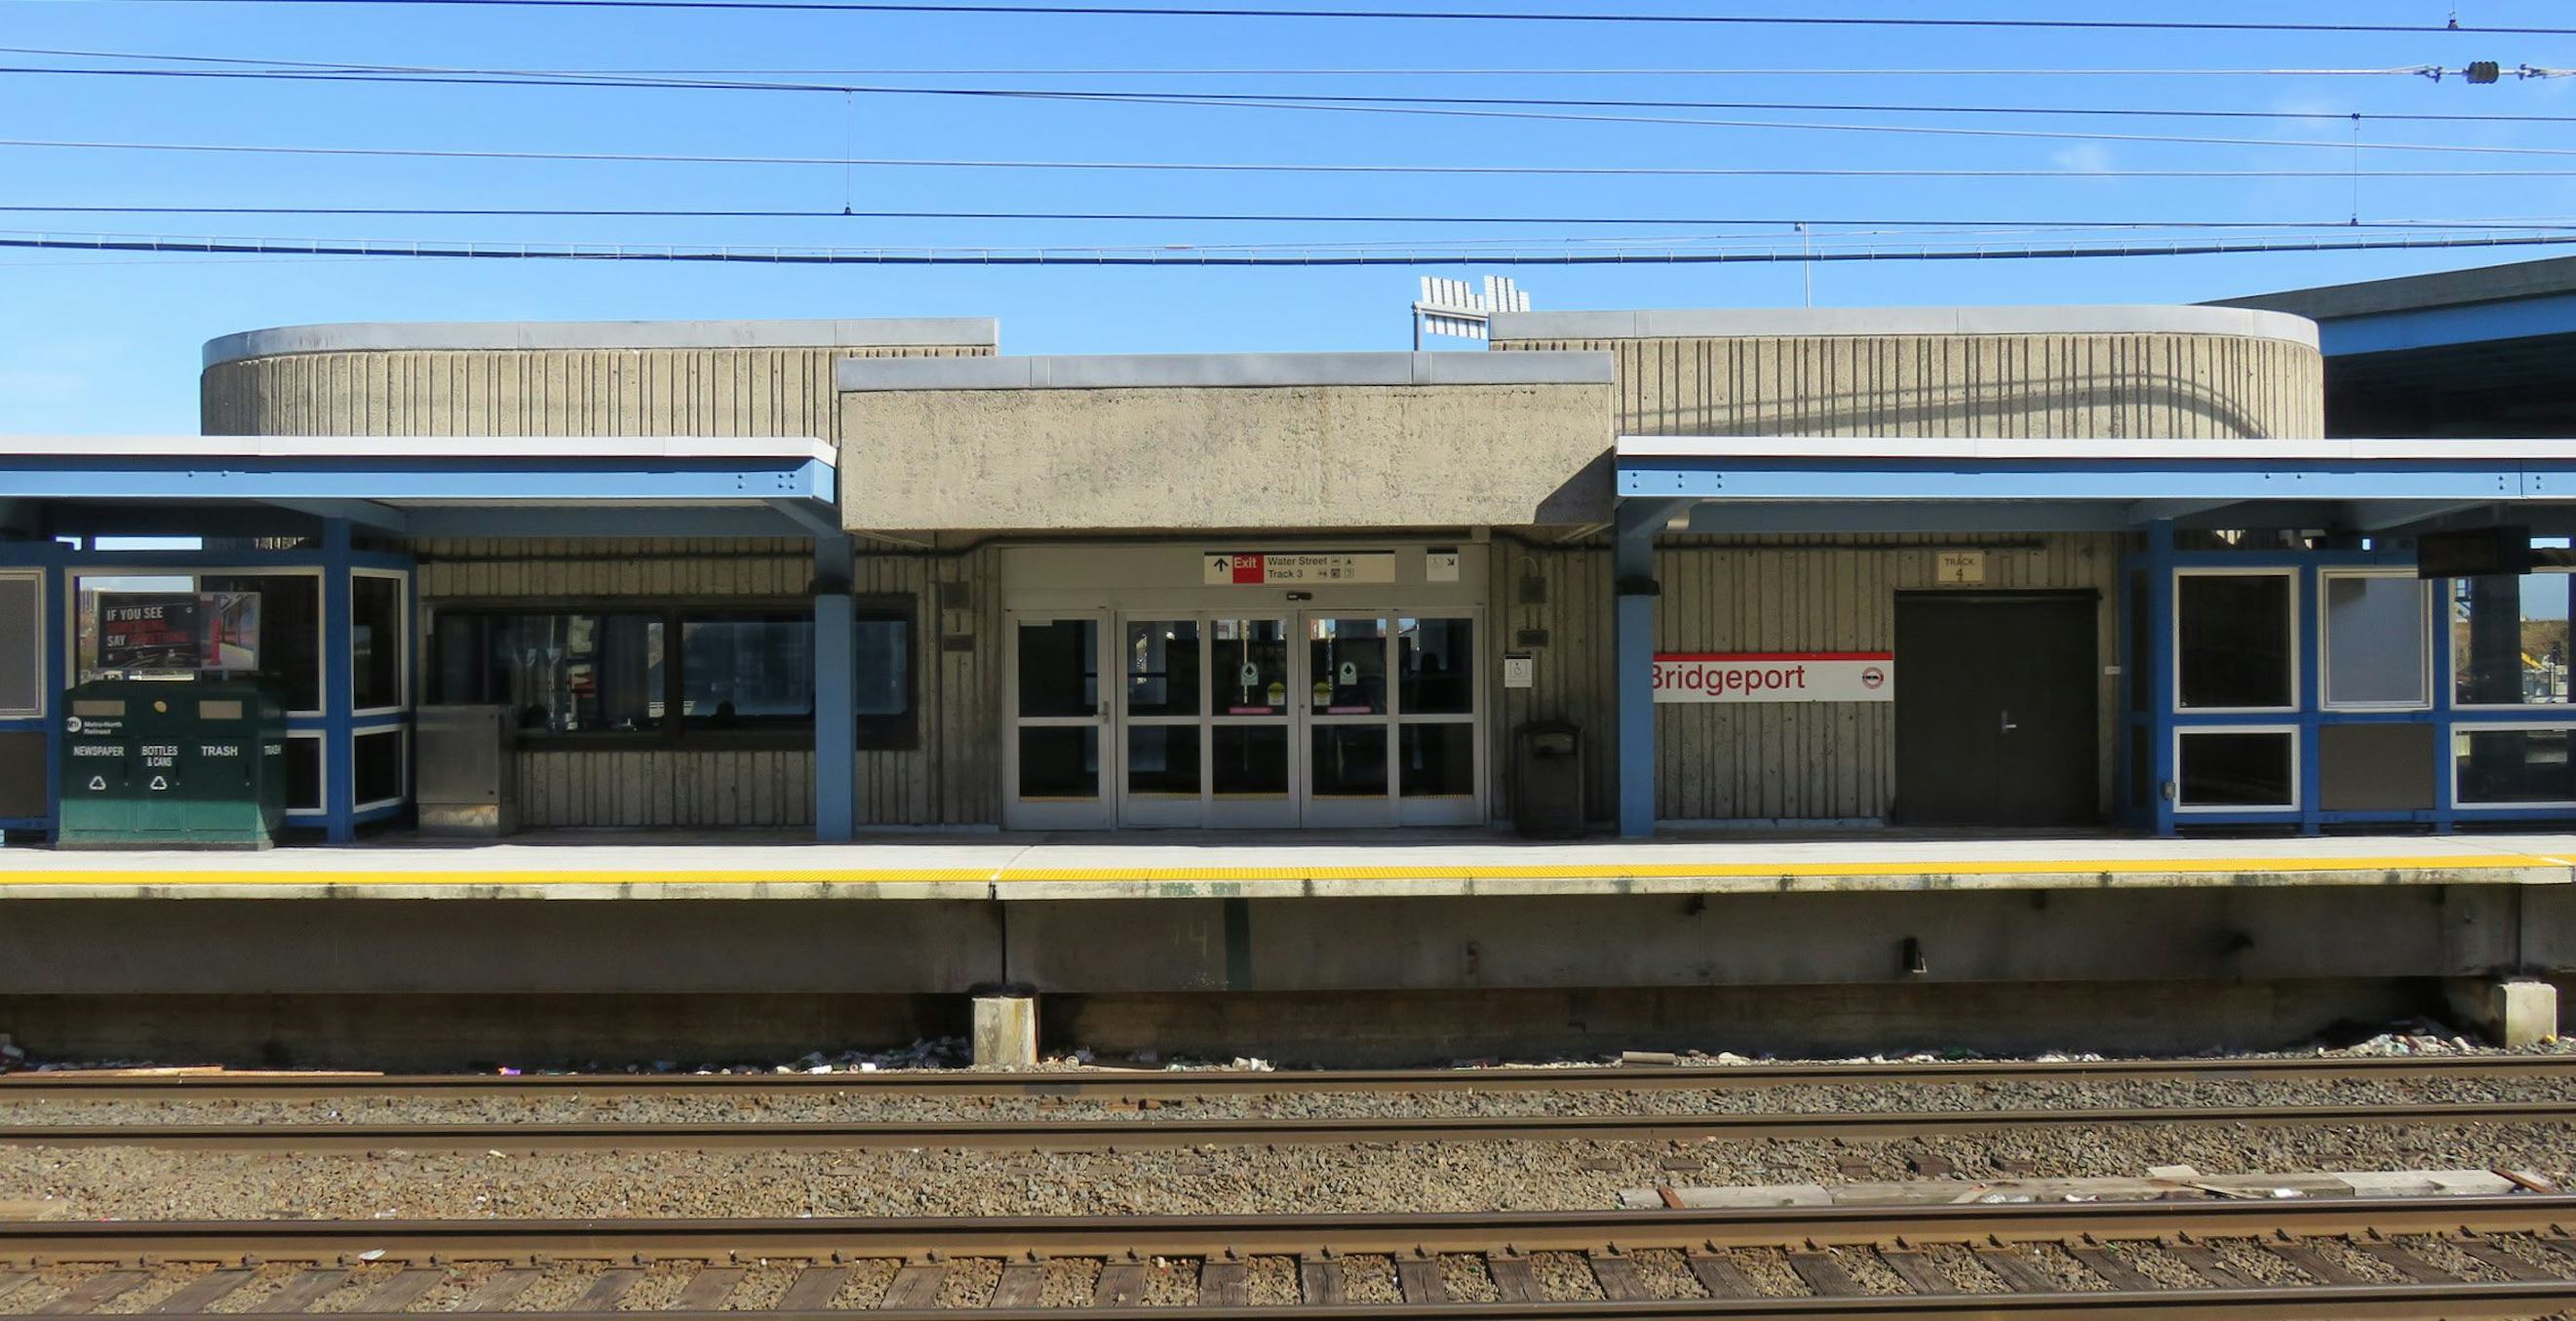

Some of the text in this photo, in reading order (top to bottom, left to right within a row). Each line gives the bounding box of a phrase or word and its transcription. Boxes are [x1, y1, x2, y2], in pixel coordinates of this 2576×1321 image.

[1233, 557, 1257, 568] Exit
[1268, 556, 1327, 566] Water Street
[1944, 558, 1974, 566] TRACK
[1268, 569, 1304, 579] Track 3
[1956, 568, 1964, 577] 4
[106, 606, 164, 621] IF YOU SEE
[106, 634, 127, 646] SAY
[1654, 664, 1805, 696] Bridgeport
[73, 746, 125, 757] NEWSPAPER
[141, 745, 178, 757] BOTTLES
[201, 745, 238, 757] TRASH
[146, 757, 173, 767] & CANS
